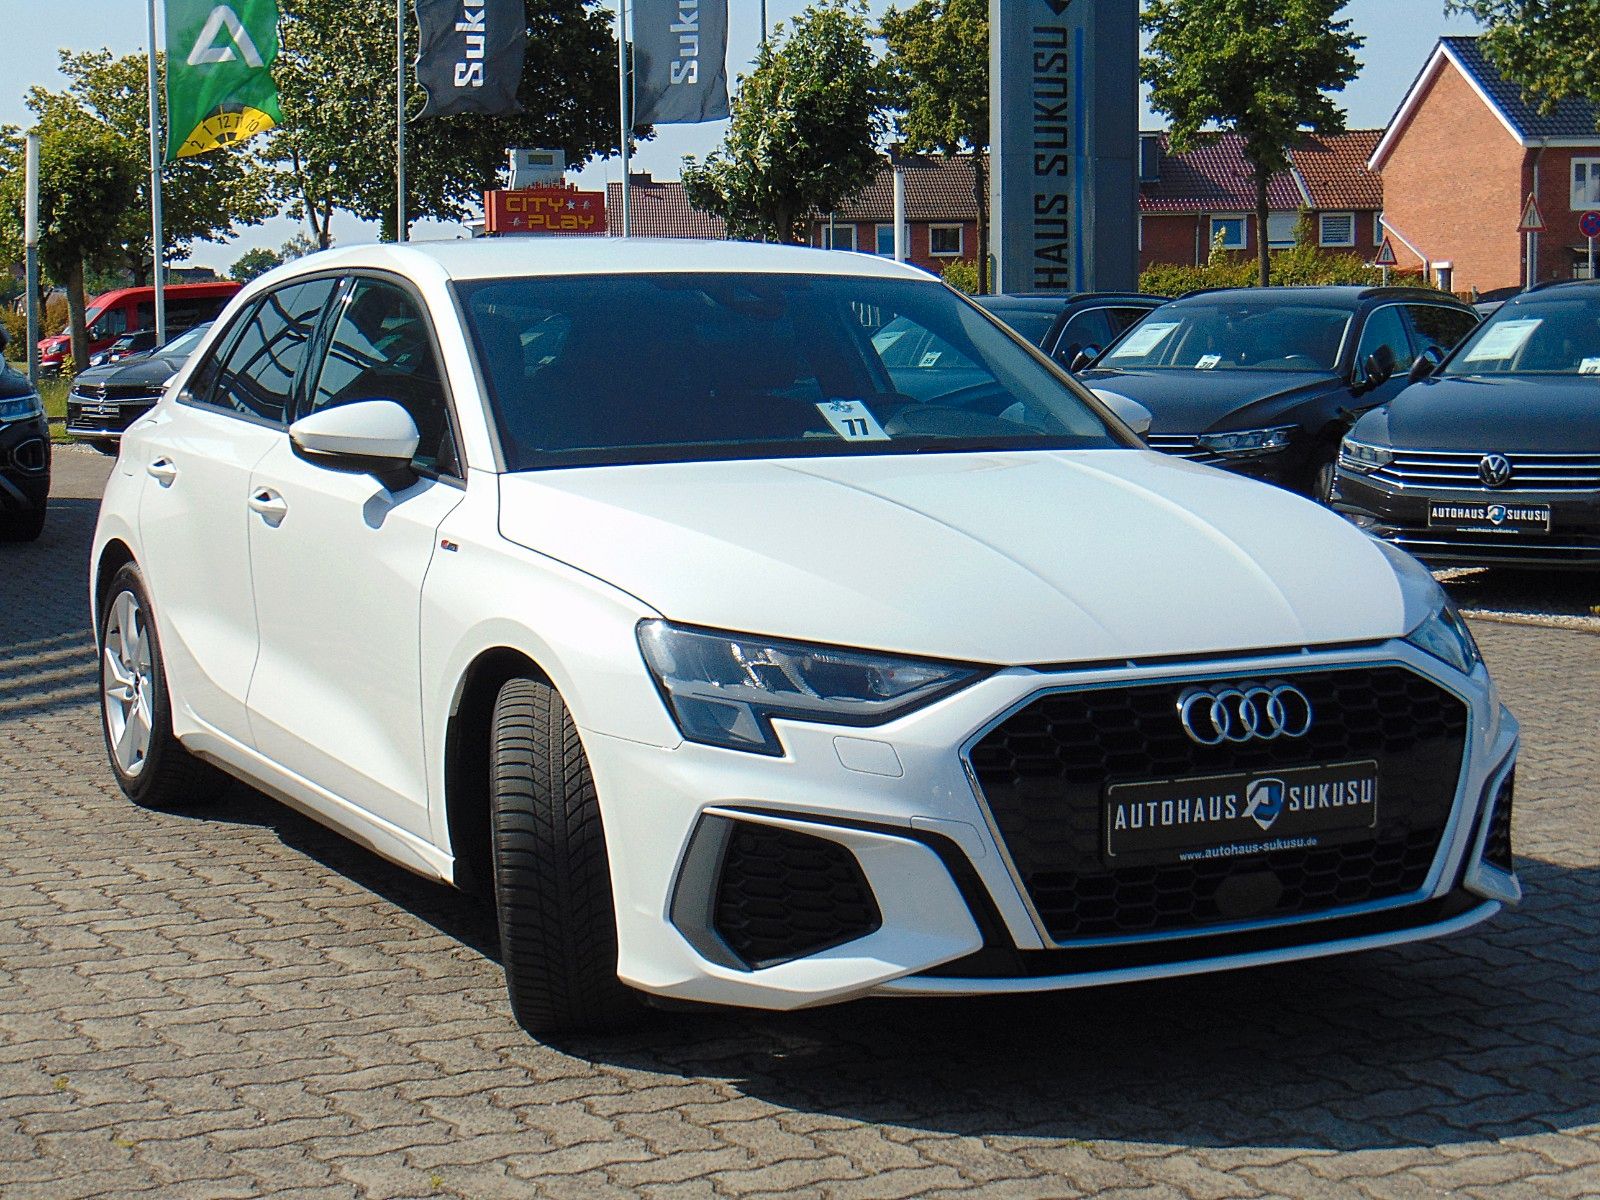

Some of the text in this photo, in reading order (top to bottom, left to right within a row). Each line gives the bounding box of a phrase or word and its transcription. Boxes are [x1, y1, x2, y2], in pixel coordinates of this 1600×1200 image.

[203, 124, 213, 136] 1
[217, 115, 231, 130] 12
[246, 119, 259, 132] 10
[1034, 26, 1068, 288] HAUS SUKUSU
[505, 197, 564, 213] CITY
[841, 418, 869, 436] 77
[1432, 507, 1549, 521] AUTOHAUS SUKUSU
[1115, 779, 1372, 830] AUTOHAUS SUKUSU
[1179, 837, 1317, 861] www.autohaus-sukusu.de
